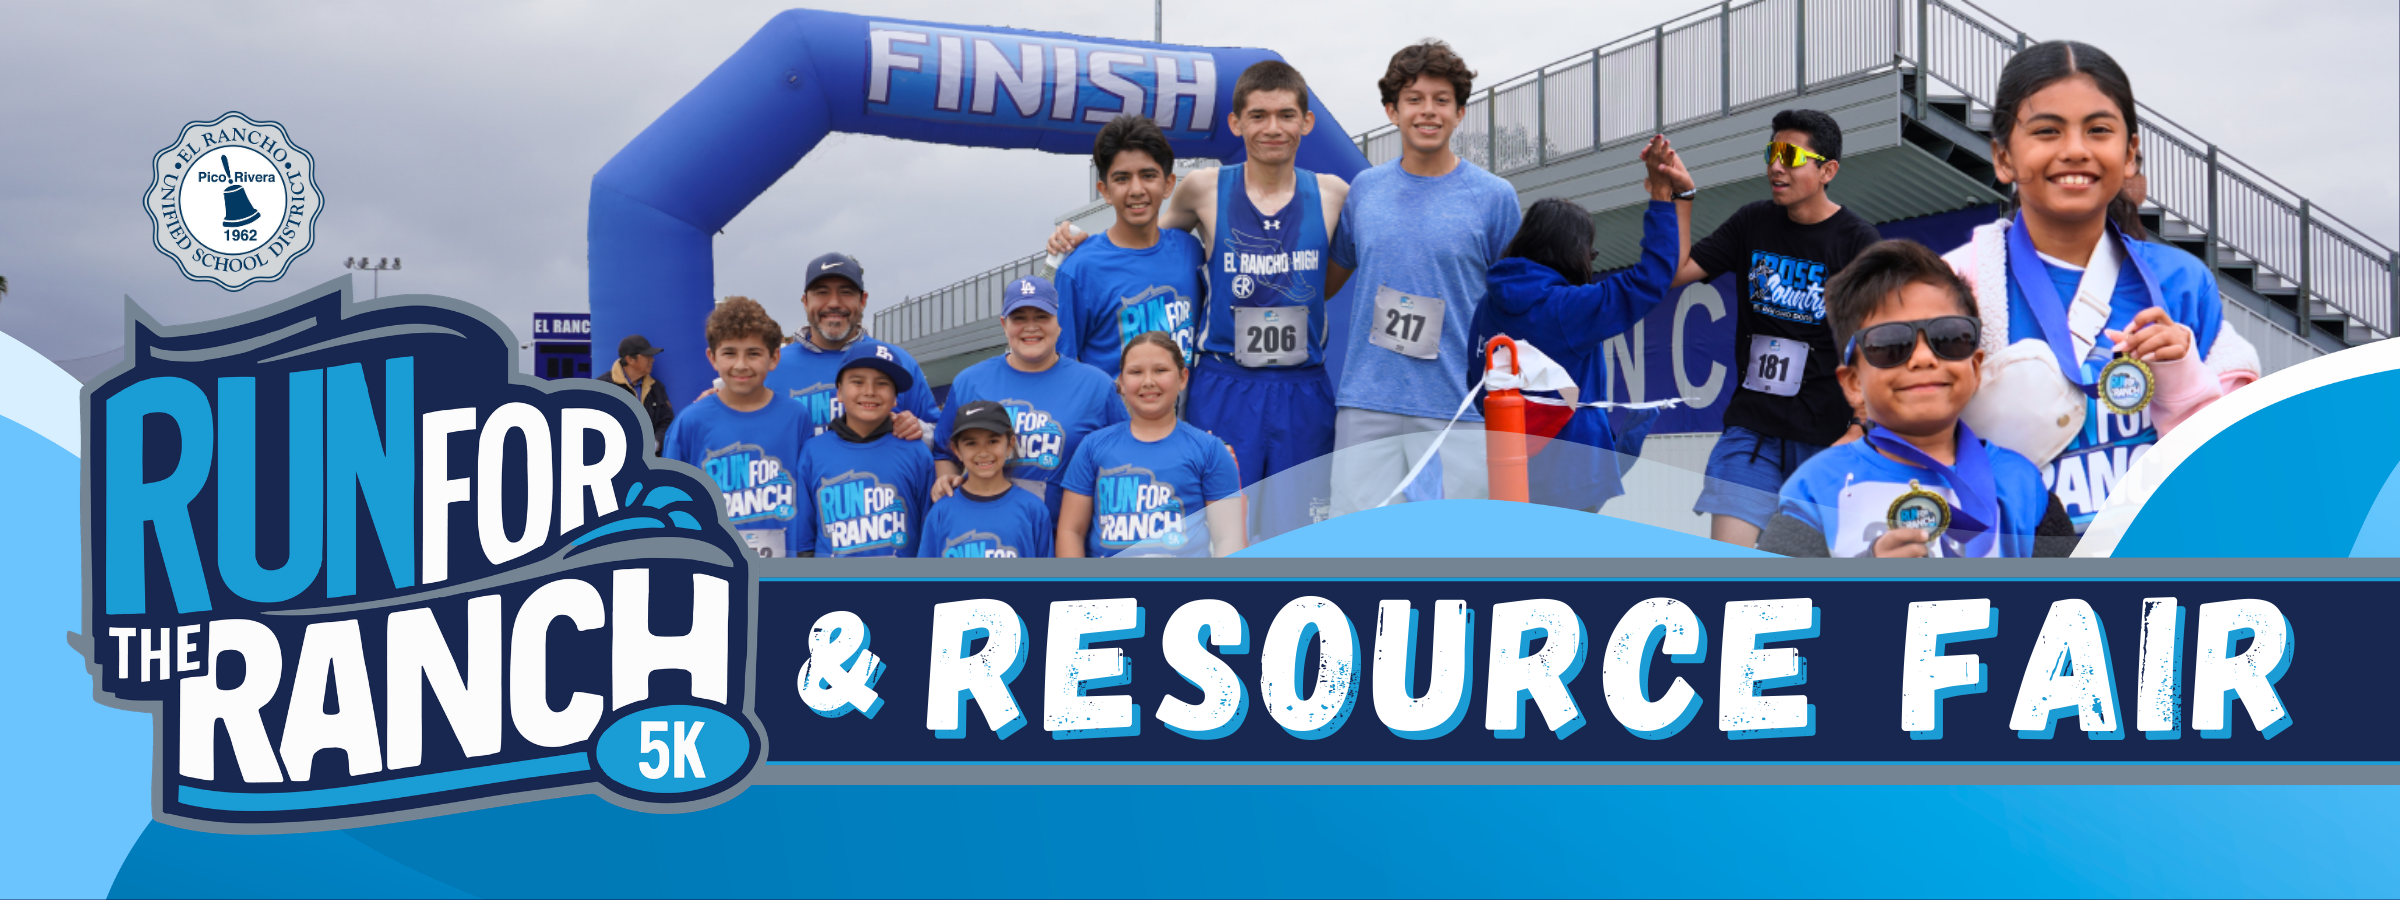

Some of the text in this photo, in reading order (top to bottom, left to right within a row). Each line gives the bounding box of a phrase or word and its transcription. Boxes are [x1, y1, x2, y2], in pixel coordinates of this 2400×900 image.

[867, 28, 1217, 132] FINISH
[1223, 249, 1319, 275] EL RANCHO HIGH
[1021, 280, 1036, 295] LA
[535, 319, 549, 334] EL
[1247, 325, 1296, 353] 206
[1385, 308, 1427, 343] 217
[1758, 354, 1790, 382] 181
[1015, 412, 1049, 435] FOR
[705, 453, 780, 492] RUN FOR
[1043, 455, 1055, 466] 5K
[820, 481, 895, 524] RUN FOR
[1098, 476, 1171, 515] RUN FOR
[832, 511, 906, 548] RANCH
[1102, 511, 1183, 541] RANCH
